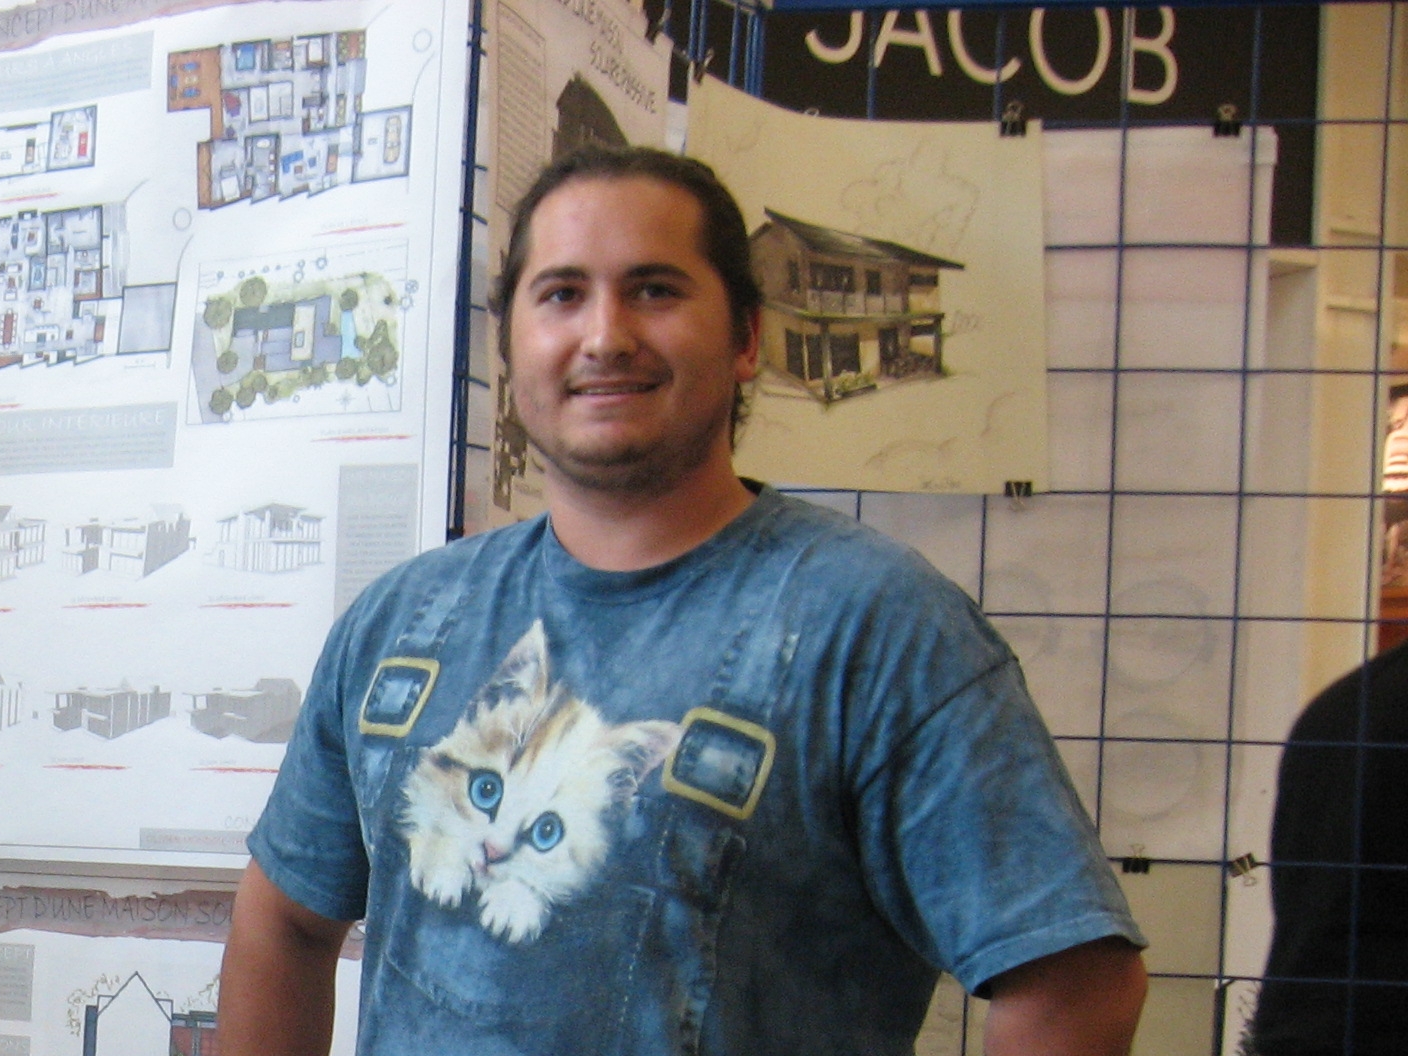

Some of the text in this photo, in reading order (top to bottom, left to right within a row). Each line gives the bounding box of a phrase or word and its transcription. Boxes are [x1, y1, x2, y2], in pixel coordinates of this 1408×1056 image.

[805, 5, 1179, 106] JACOB
[34, 895, 94, 921] D'UNE
[101, 896, 189, 924] MAISON
[195, 900, 233, 927] SO
